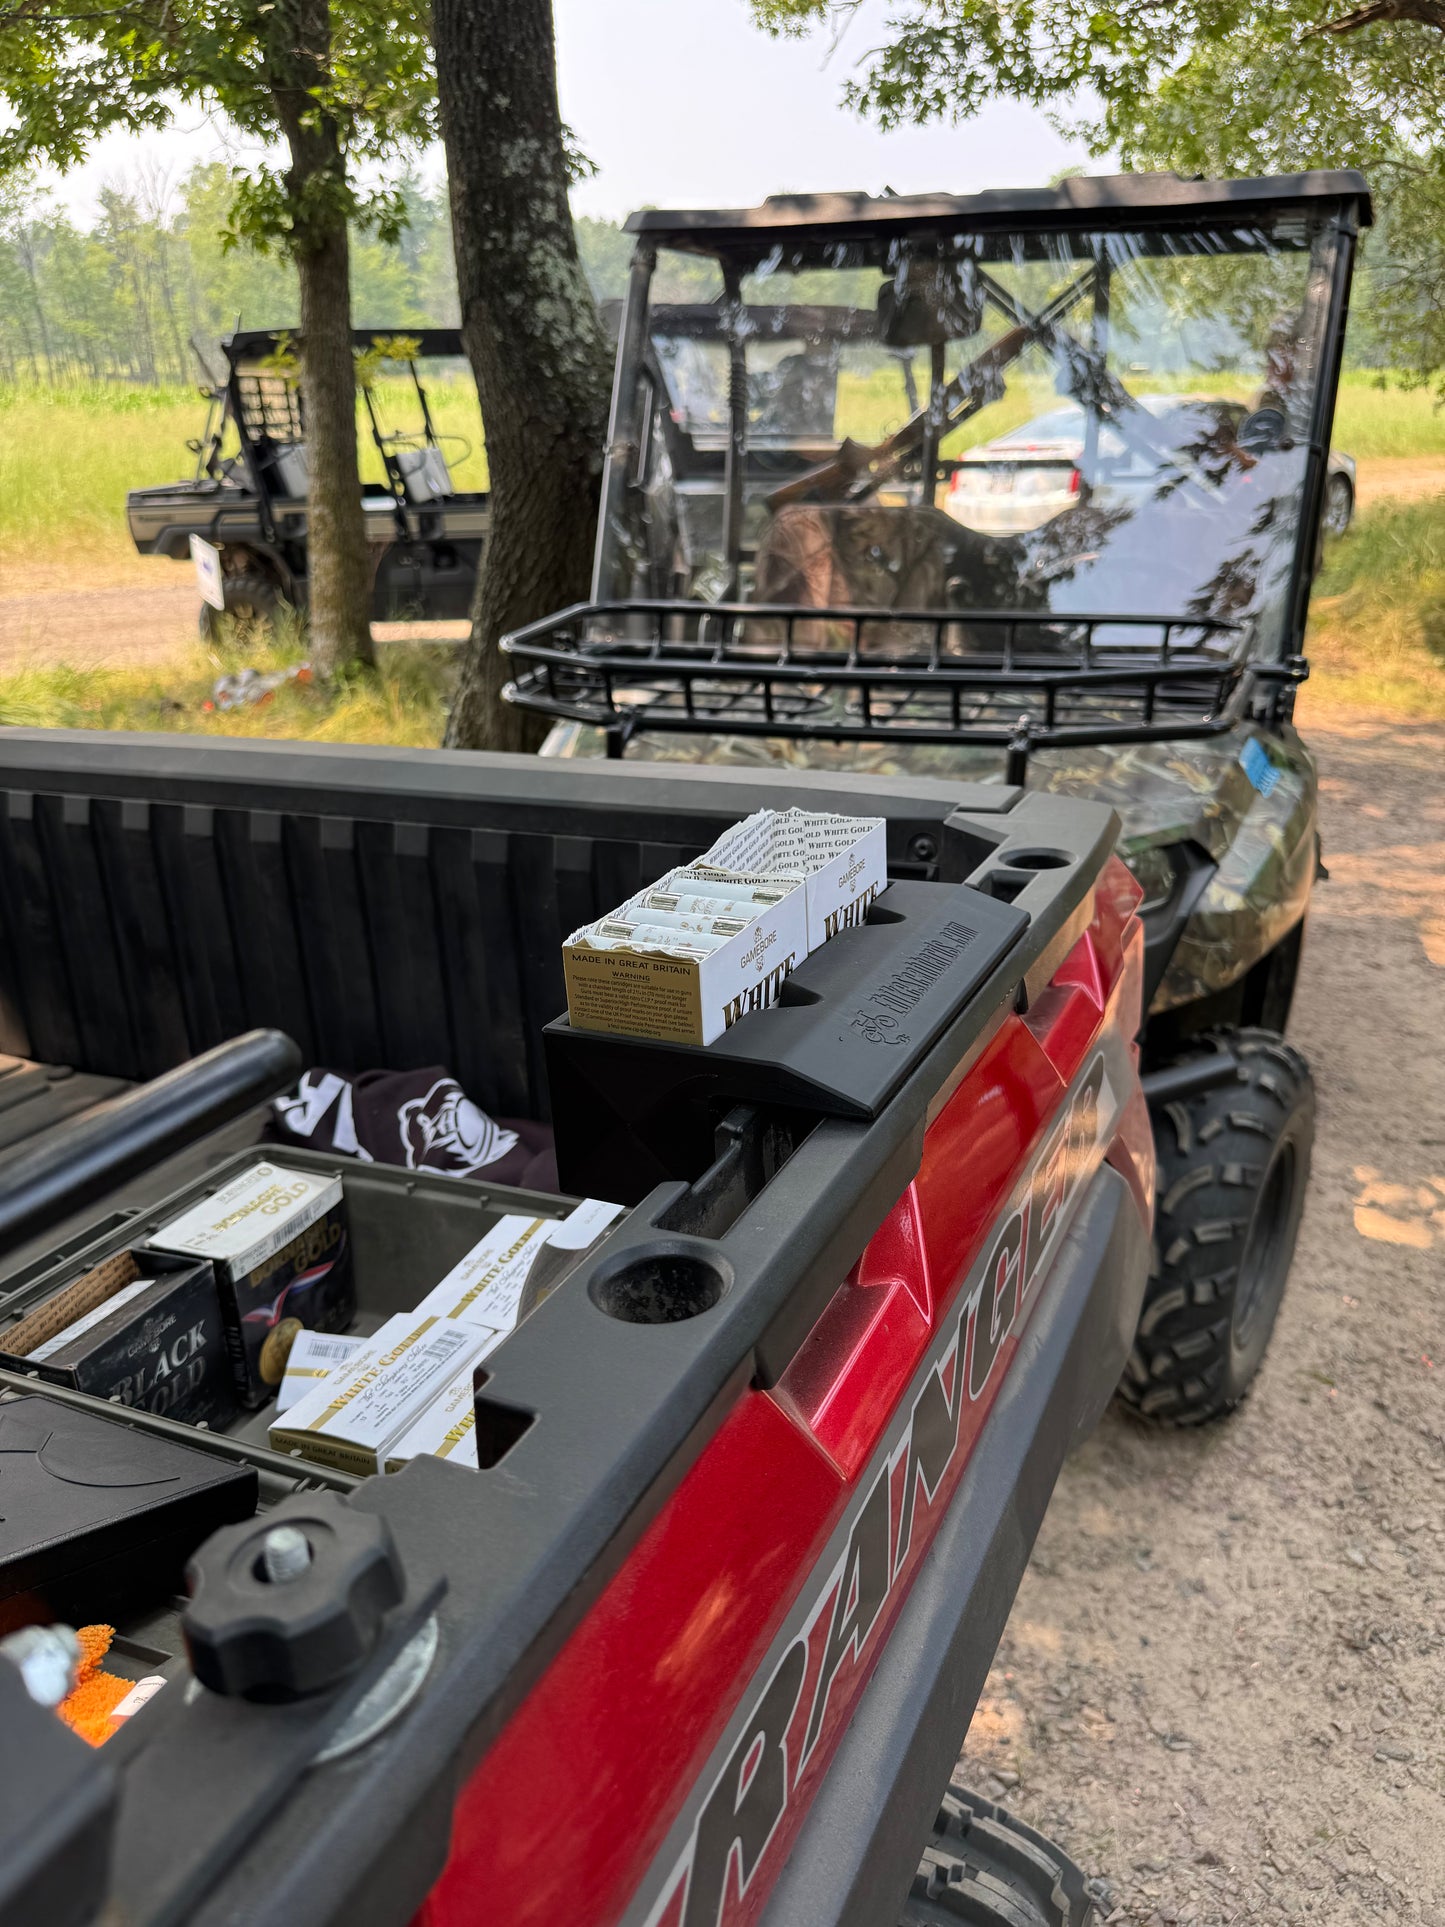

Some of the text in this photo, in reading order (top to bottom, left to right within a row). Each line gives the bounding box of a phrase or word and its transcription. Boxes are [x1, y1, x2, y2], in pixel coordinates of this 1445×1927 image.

[808, 841, 833, 849] WHITE
[850, 826, 873, 834] GOLD
[838, 858, 866, 888] GAMEBORE
[572, 954, 691, 975] MADE IN GREAT BRITAIN
[741, 929, 777, 968] GAMEBORE
[612, 971, 651, 981] WARNING
[261, 1181, 310, 1216] GOLD
[461, 1266, 503, 1302] WHITE
[498, 1230, 534, 1265] GOLD
[110, 1319, 207, 1405] BLACK
[328, 1367, 384, 1410] WHITE
[379, 1329, 424, 1367] GOLD
[275, 1437, 297, 1448] MADE
[301, 1442, 311, 1451] IN
[312, 1446, 337, 1457] GREAT
[340, 1451, 370, 1465] BRITAIN
[678, 1050, 1105, 1927] RANGER
